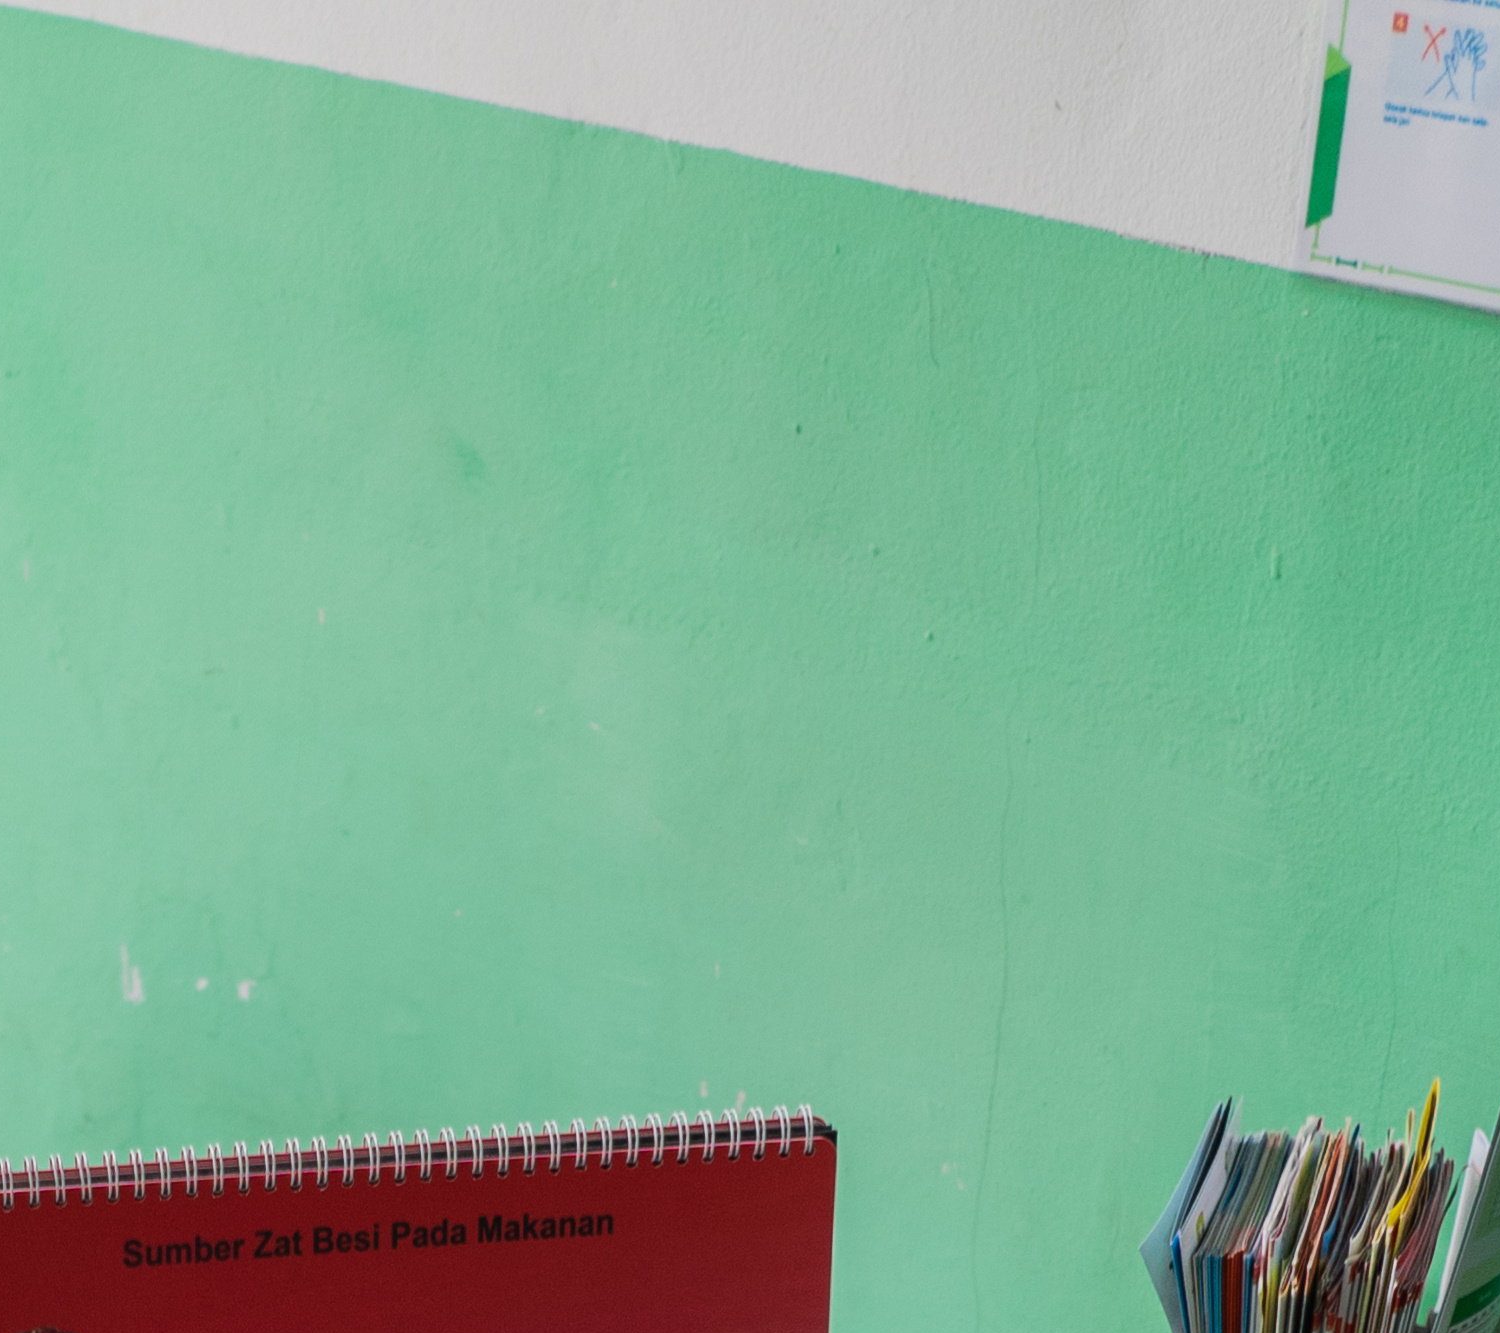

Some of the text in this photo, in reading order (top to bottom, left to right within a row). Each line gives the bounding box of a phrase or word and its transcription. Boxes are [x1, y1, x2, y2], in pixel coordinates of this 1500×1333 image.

[122, 1205, 614, 1268] Sumber Zat Besi Pada Makanan
